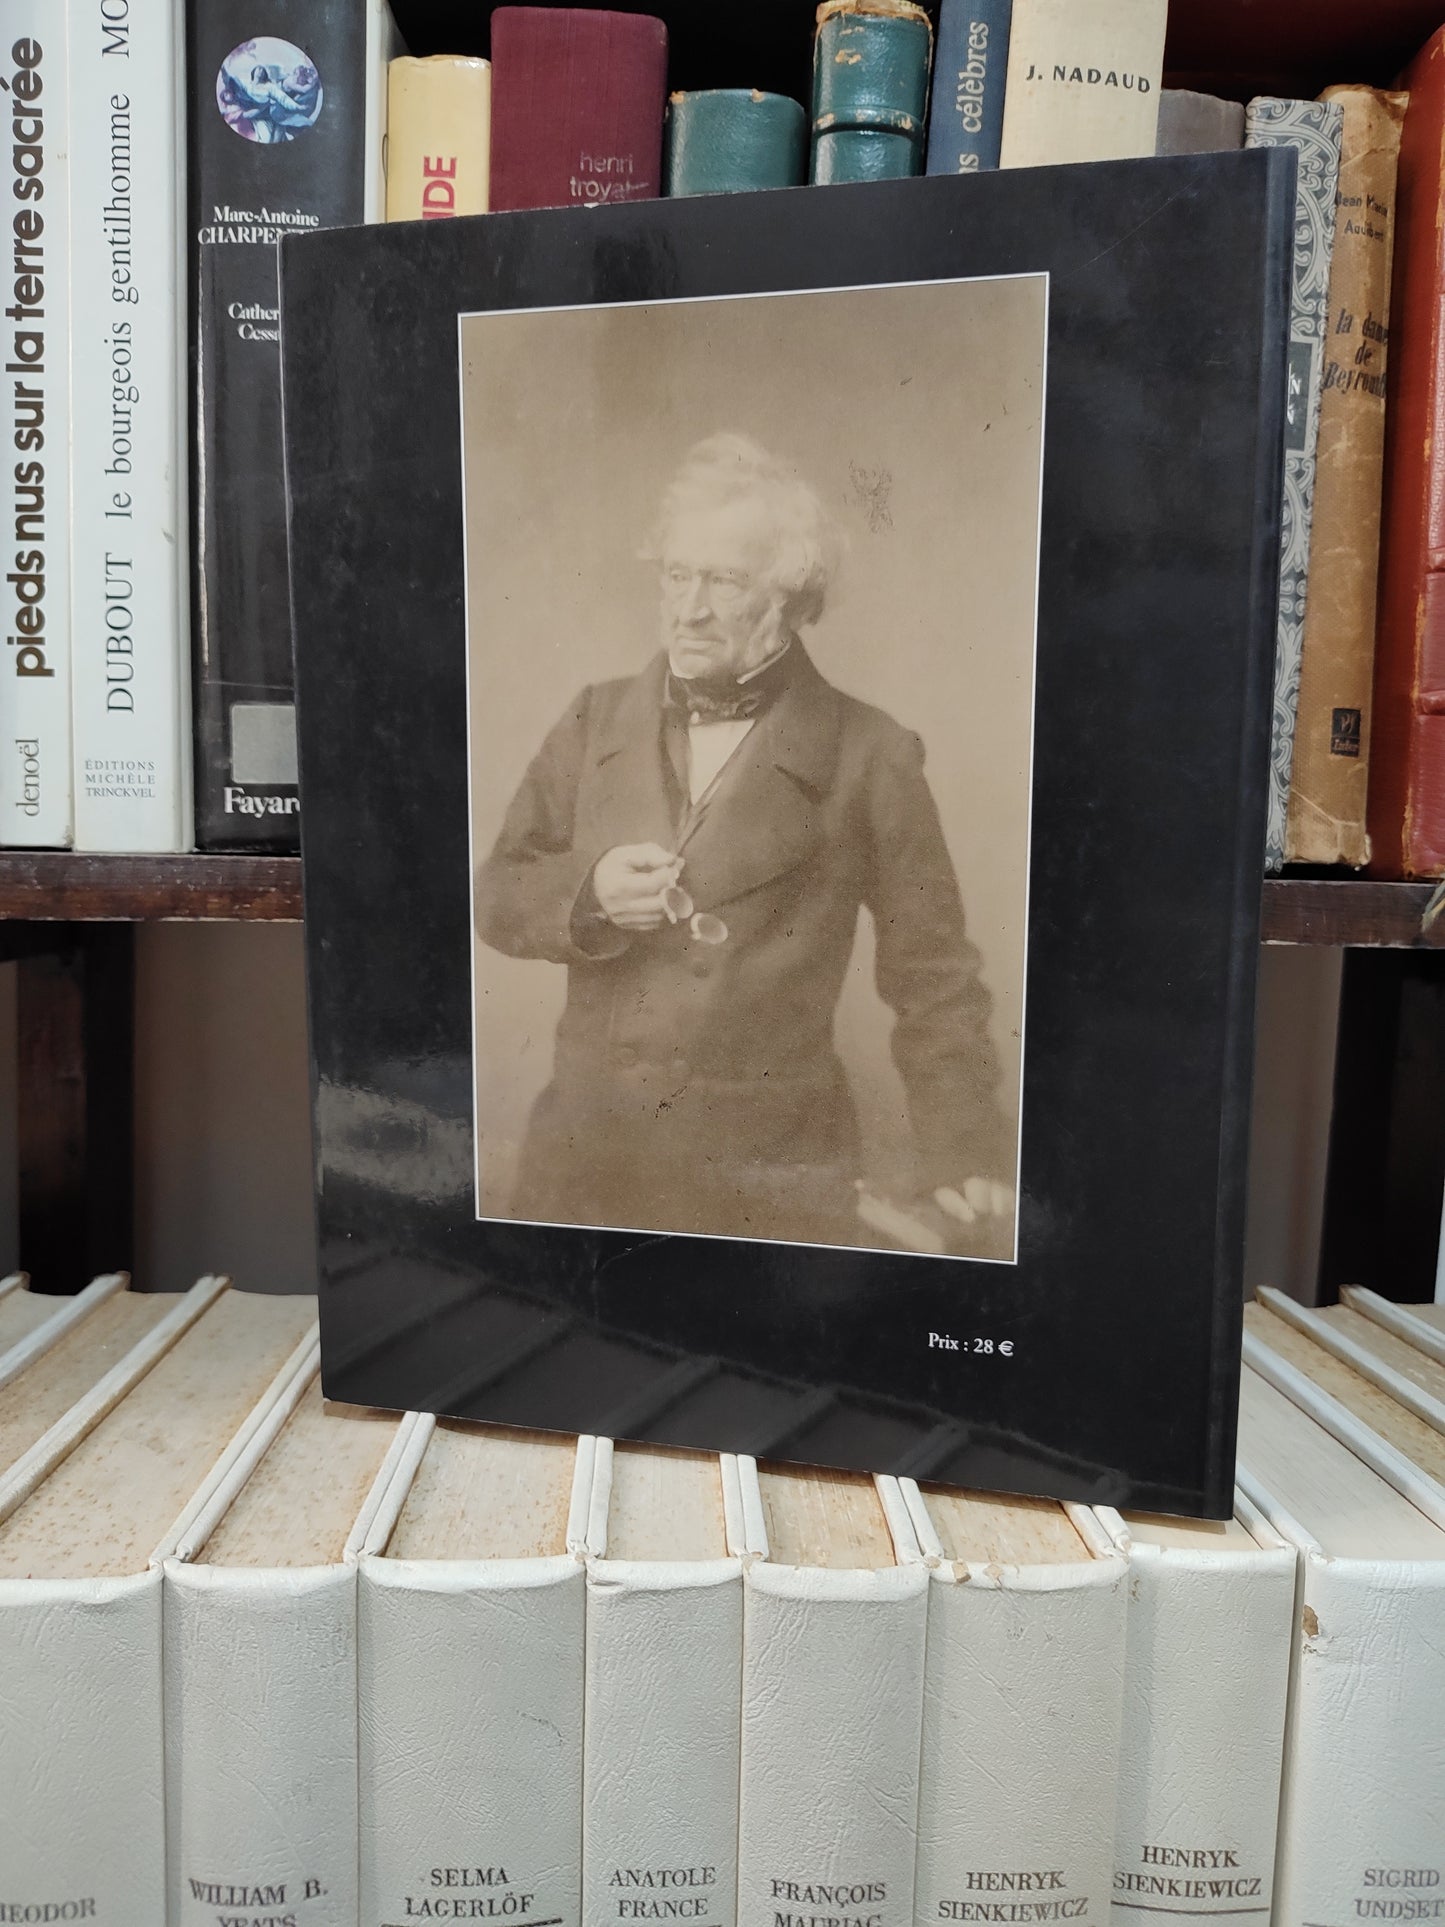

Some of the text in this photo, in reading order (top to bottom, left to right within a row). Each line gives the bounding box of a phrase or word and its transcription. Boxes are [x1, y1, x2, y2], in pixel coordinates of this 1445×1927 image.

[956, 22, 988, 133] célèbres
[1026, 65, 1151, 93] J. NADAUD
[580, 151, 633, 173] henri
[103, 94, 139, 304] gentilhomme
[213, 205, 320, 227] Marc-Antoine
[198, 226, 312, 245] CHARPE
[0, 38, 54, 677] pieds nus sur la terre sacrée
[1355, 339, 1373, 367] de
[104, 322, 139, 475] bourgeois
[105, 492, 132, 519] le
[105, 552, 134, 713] DUBOUT
[16, 738, 40, 817] denoël
[85, 759, 155, 771] ÉDITIONS
[86, 772, 155, 784] MICHÈLE
[86, 786, 156, 798] TRINCKVEL
[928, 1332, 959, 1351] Prix
[973, 1338, 994, 1354] 28
[998, 1340, 1015, 1357] €
[1141, 1845, 1240, 1868] HENRYK
[430, 1867, 511, 1888] SELMA
[608, 1866, 717, 1888] ANATOLE
[966, 1871, 1067, 1892] HENRYK
[1112, 1871, 1262, 1898] SIENKIEWICZ
[1363, 1868, 1440, 1888] SIGRID
[188, 1877, 328, 1907] WILLIAM B.
[771, 1878, 887, 1908] FRANÇOIS
[404, 1892, 535, 1918] LAGERLÖF
[616, 1898, 709, 1919] FRANCE
[938, 1897, 1090, 1923] SIENKIEWICZ
[1354, 1898, 1445, 1921] UNDSET
